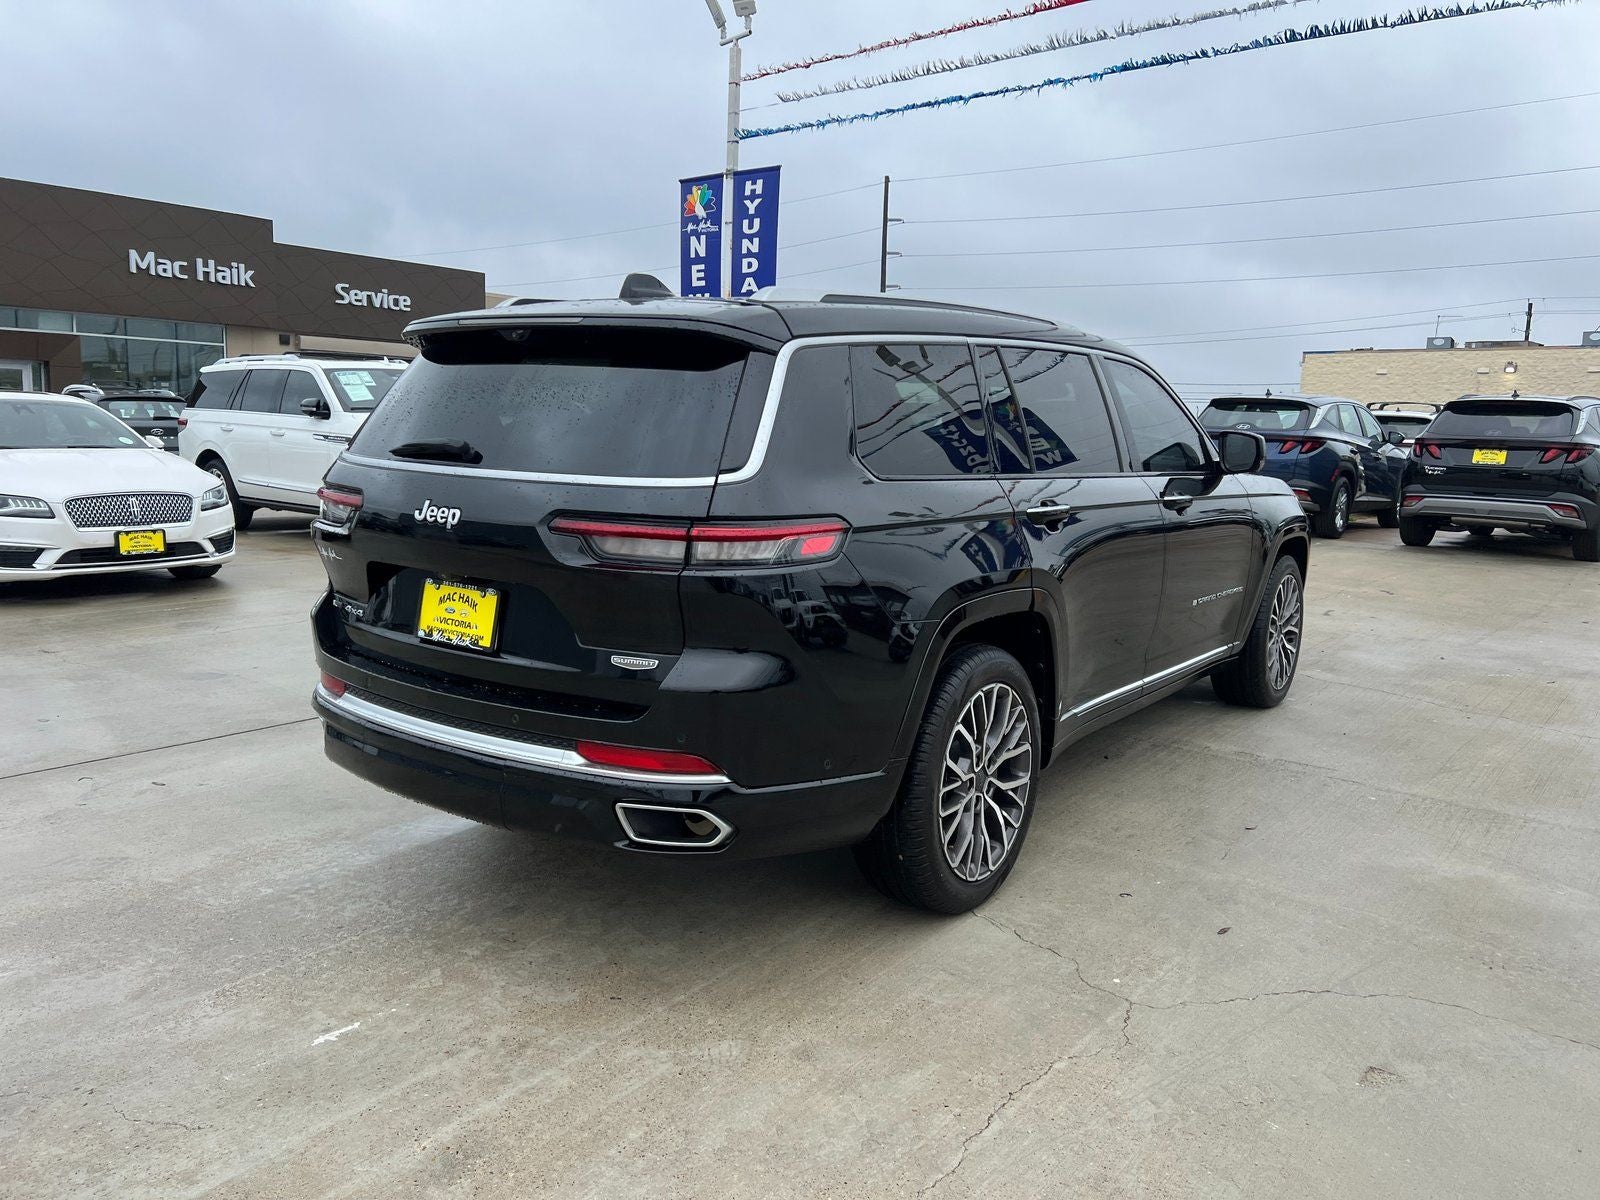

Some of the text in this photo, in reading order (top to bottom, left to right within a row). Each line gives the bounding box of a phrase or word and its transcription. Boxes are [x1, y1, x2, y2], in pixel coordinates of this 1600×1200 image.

[128, 249, 256, 288] Mac Haik
[334, 283, 412, 312] Service
[413, 499, 462, 530] Jeep
[438, 592, 457, 606] MAC
[458, 593, 479, 612] HAIK
[439, 616, 472, 630] VICTORIA
[428, 629, 483, 651] Mac Haik
[613, 657, 655, 666] SUMMIT
